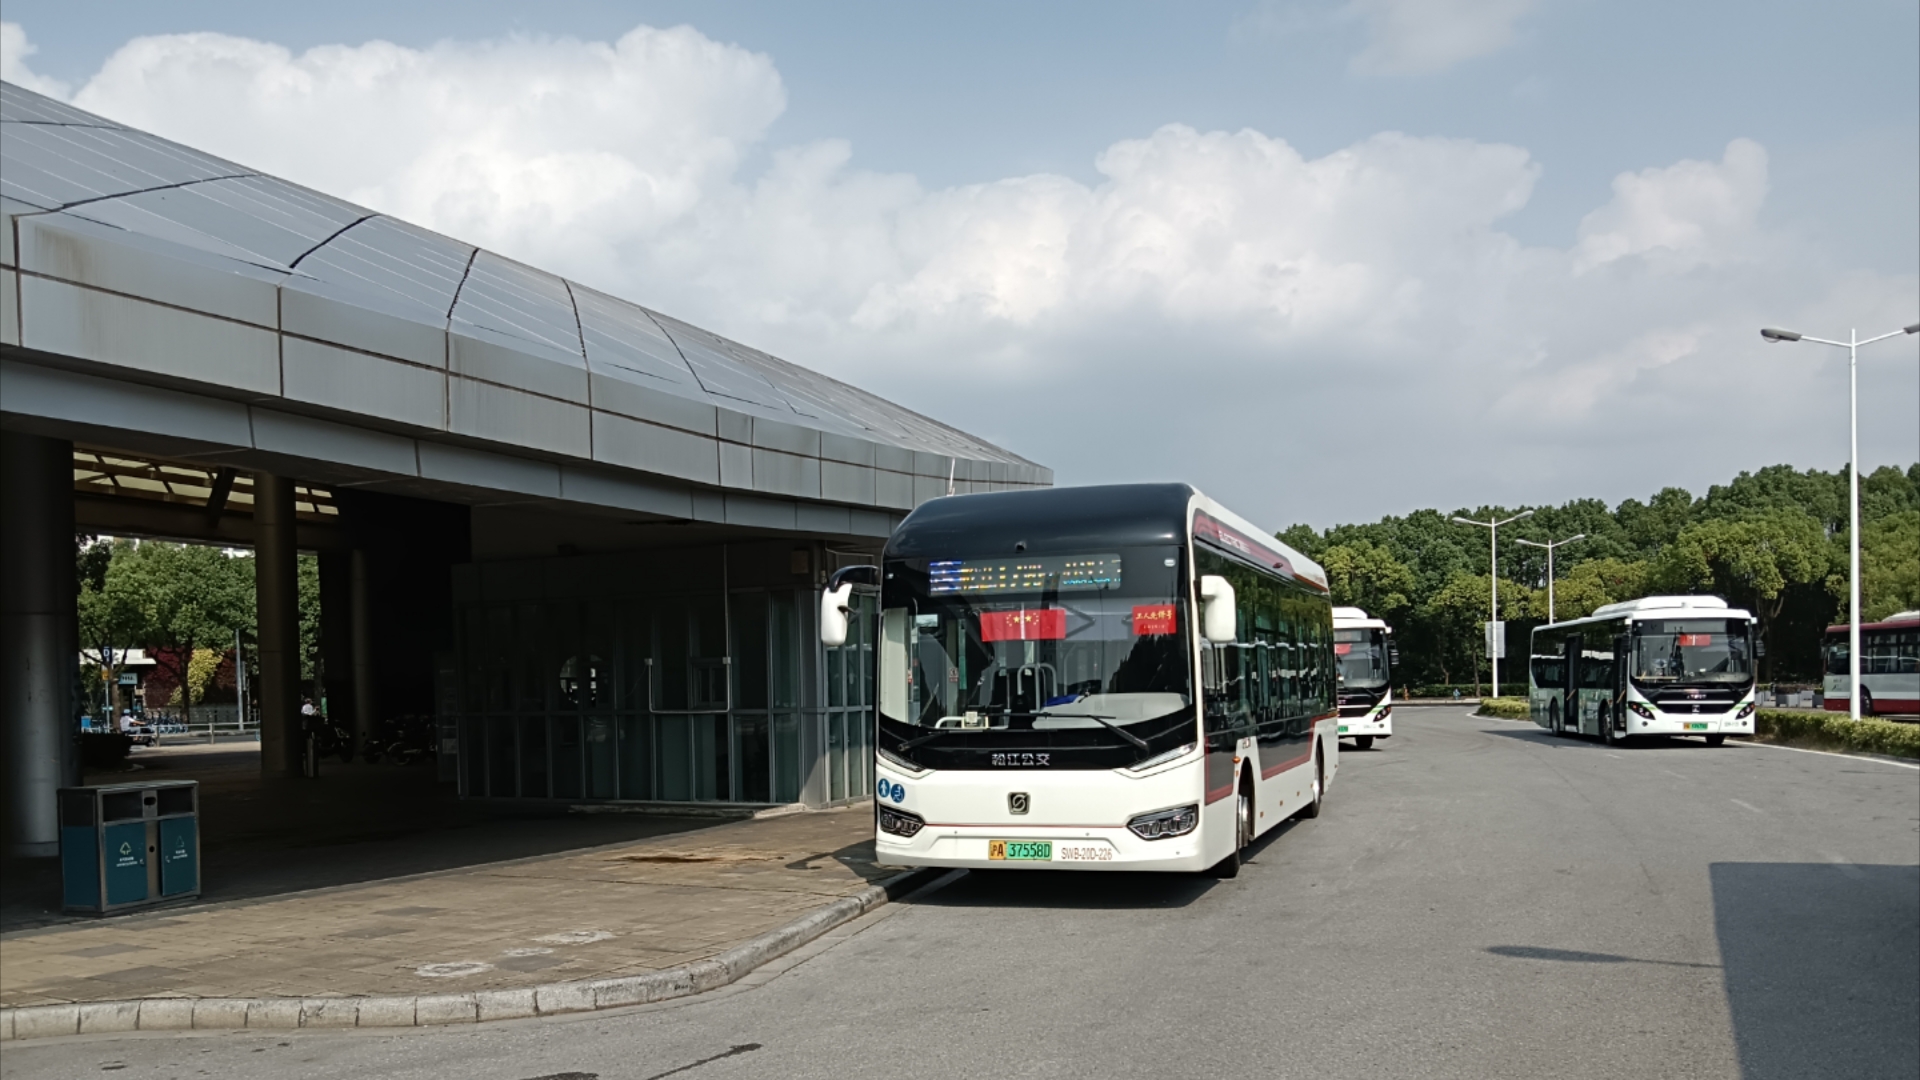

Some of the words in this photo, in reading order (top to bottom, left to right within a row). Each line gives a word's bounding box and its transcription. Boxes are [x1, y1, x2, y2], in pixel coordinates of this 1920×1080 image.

[991, 752, 1051, 767] 松江公交
[1008, 843, 1051, 858] 37558D
